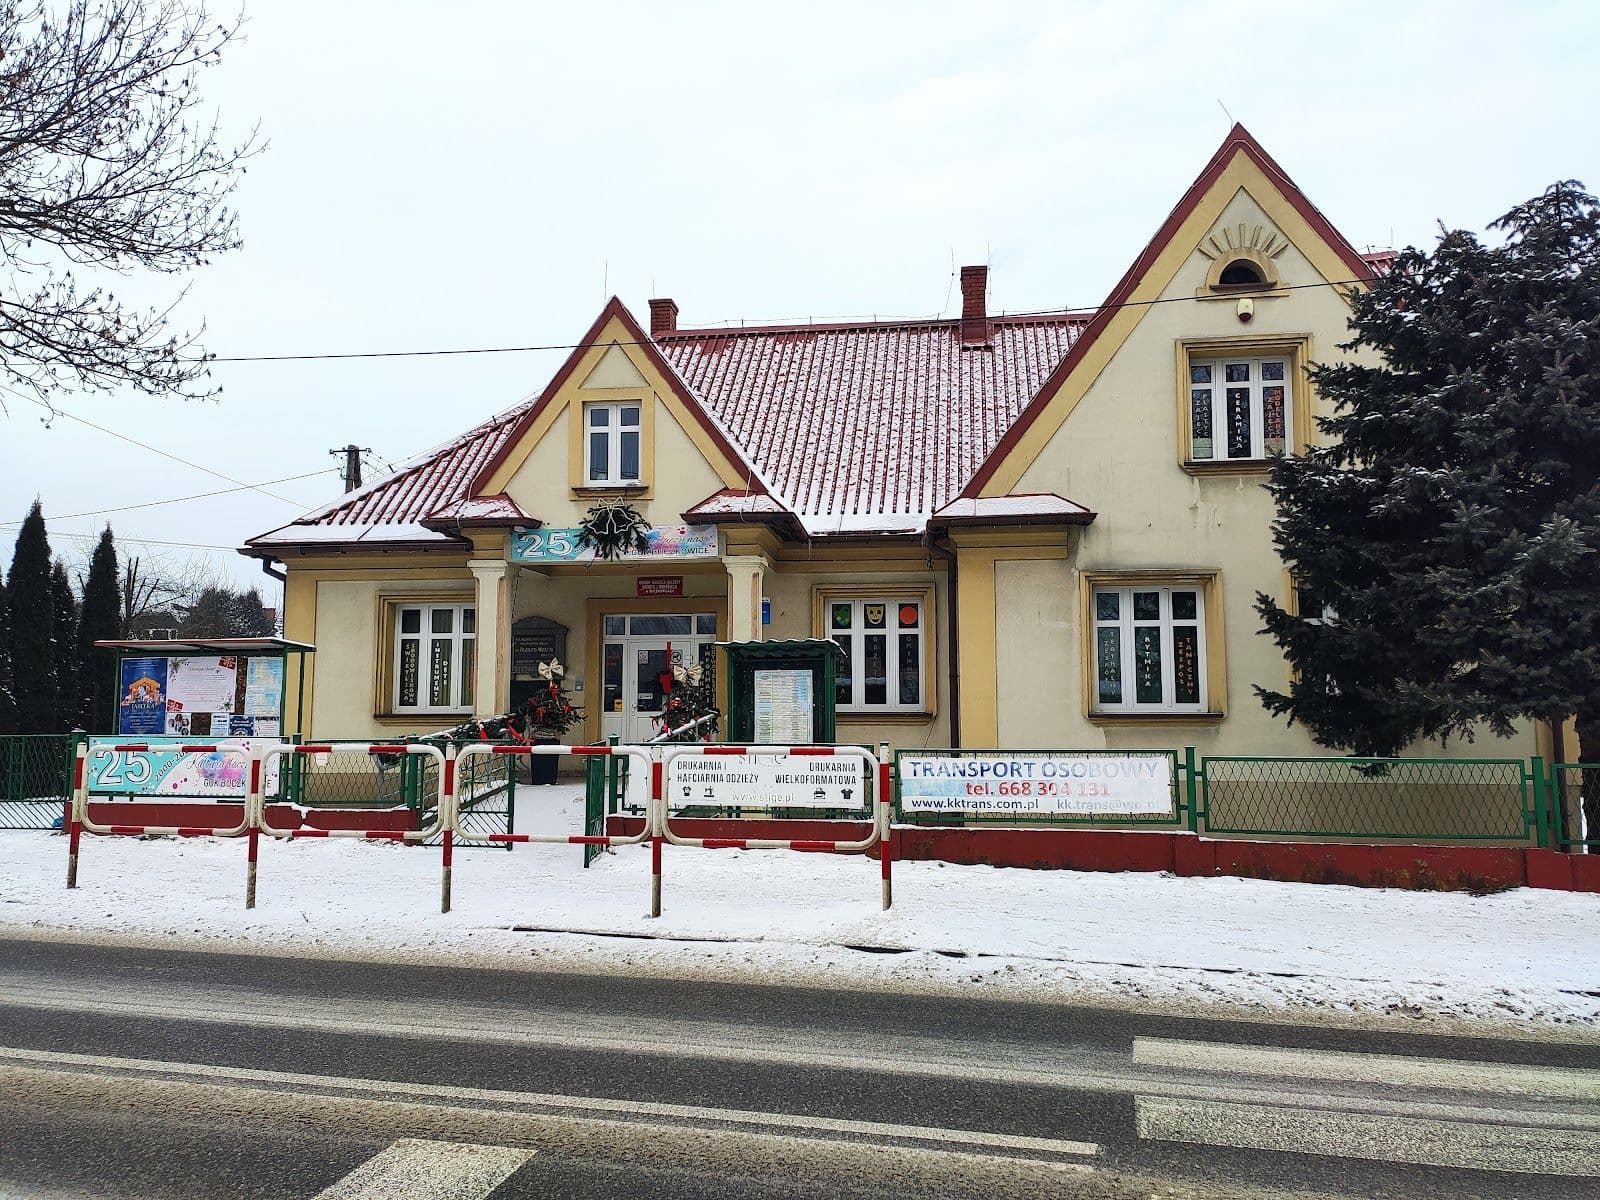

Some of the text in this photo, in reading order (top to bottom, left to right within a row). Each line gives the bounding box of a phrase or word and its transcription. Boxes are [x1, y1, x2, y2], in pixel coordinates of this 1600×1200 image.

[1235, 392, 1243, 449] CERAMIKA
[521, 532, 573, 557] 25
[1144, 636, 1152, 687] RYTMIKA
[1185, 637, 1194, 695] TANECZNY
[95, 742, 152, 785] 25
[677, 760, 721, 771] DRUKARNIA
[809, 762, 857, 773] DRUKARNIA
[909, 761, 1159, 778] TRANSPORT OSOBOWY
[677, 773, 760, 784] HAFCIARNIA ODZIEŻY
[775, 774, 857, 785] WIELKOFORMATOWA
[966, 782, 1111, 796] tel. 668 304 131
[912, 798, 1039, 811] www.kktrans.com.pl
